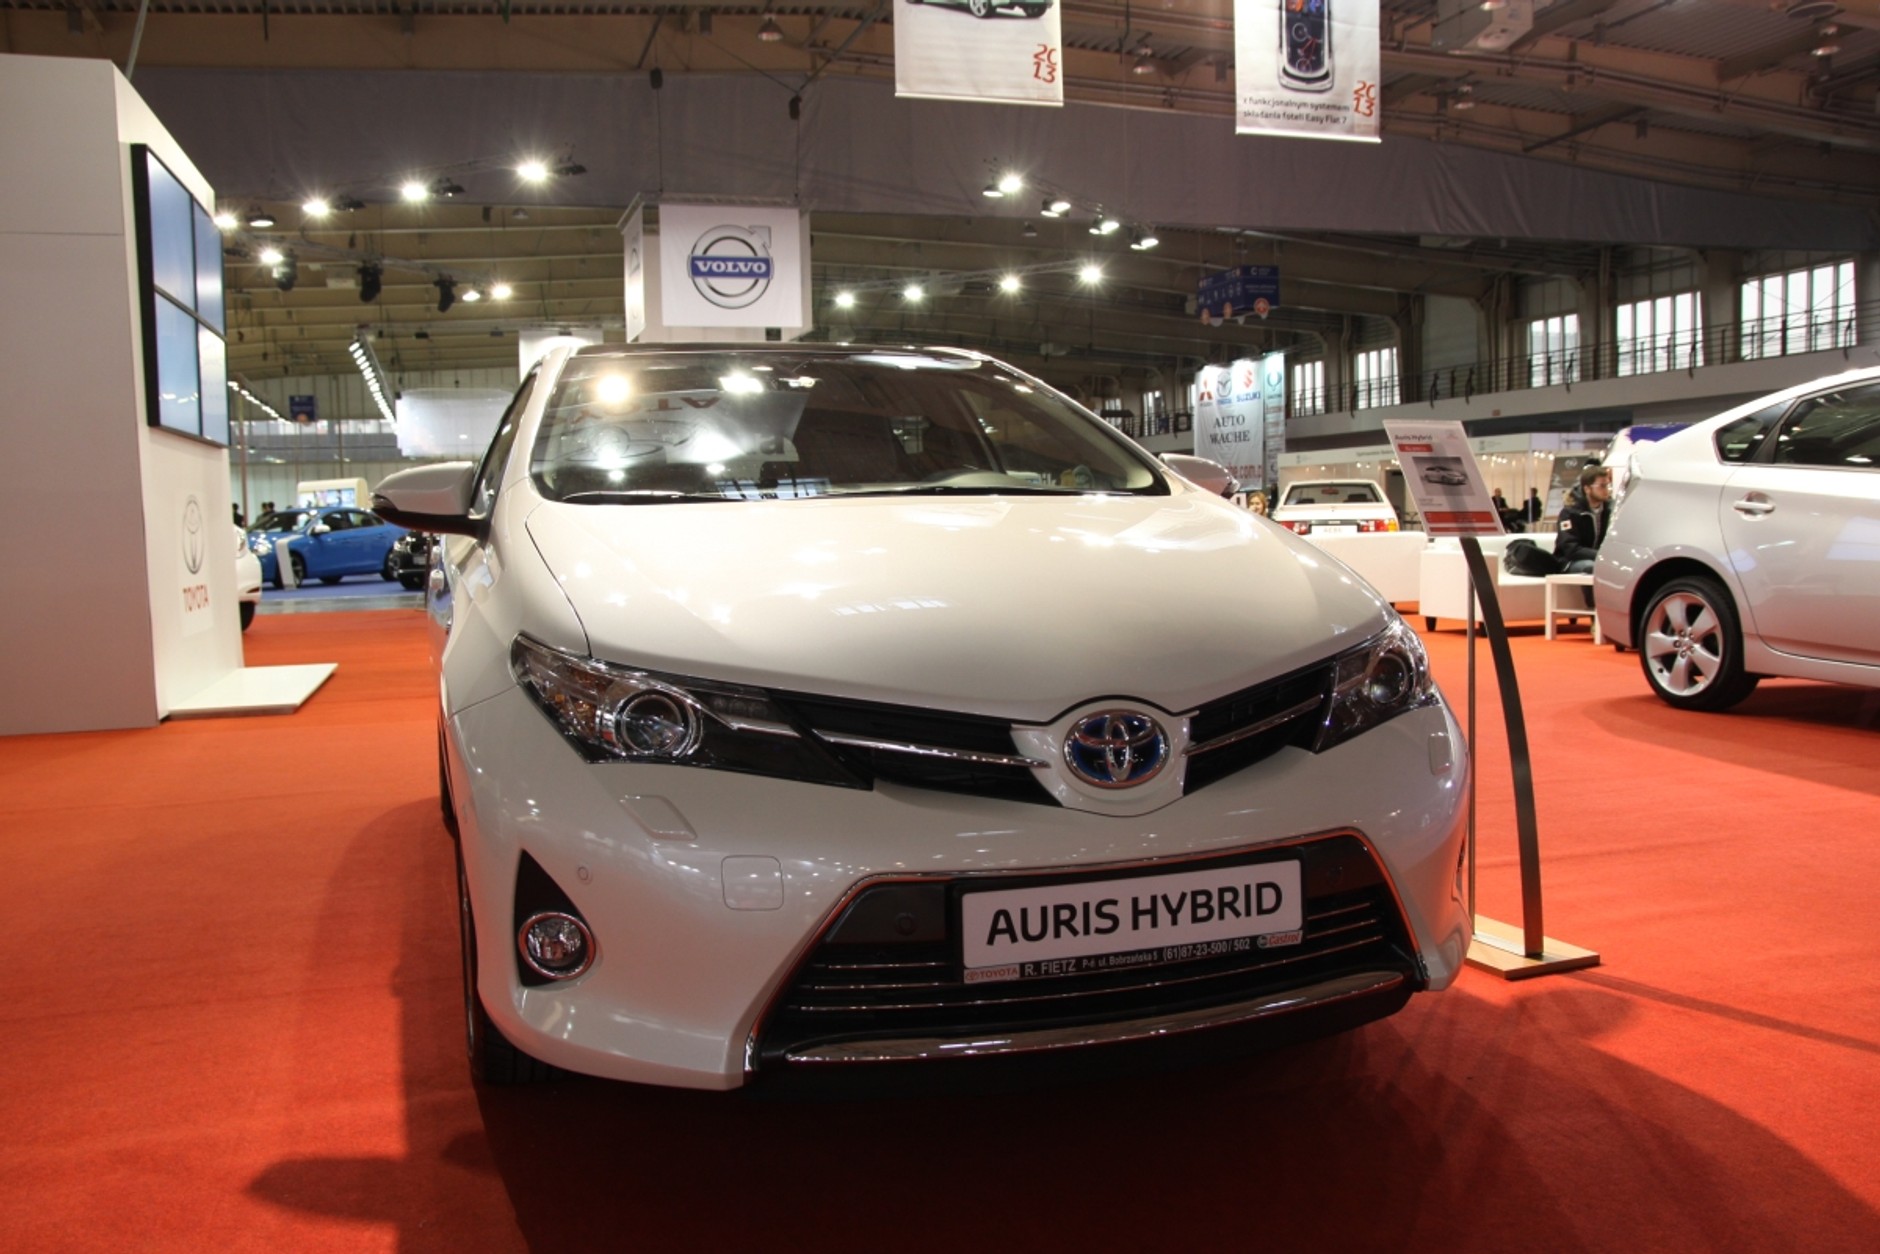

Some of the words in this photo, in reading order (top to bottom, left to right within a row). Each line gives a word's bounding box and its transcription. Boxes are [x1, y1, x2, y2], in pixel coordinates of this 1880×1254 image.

[1305, 114, 1324, 125] Easy
[1325, 114, 1340, 124] Flat
[695, 260, 767, 274] VOLVO
[1236, 391, 1261, 403] SUZUKI
[1213, 414, 1245, 429] AUTO
[1209, 430, 1251, 445] WACHE
[183, 584, 209, 613] TOYOTA
[986, 898, 1120, 946] AURIS
[1131, 881, 1283, 931] HYBRID
[979, 967, 1018, 980] TOYOTA
[1024, 964, 1037, 976] R.
[1040, 960, 1077, 975] FIETZ
[1269, 931, 1300, 946] Castrol
